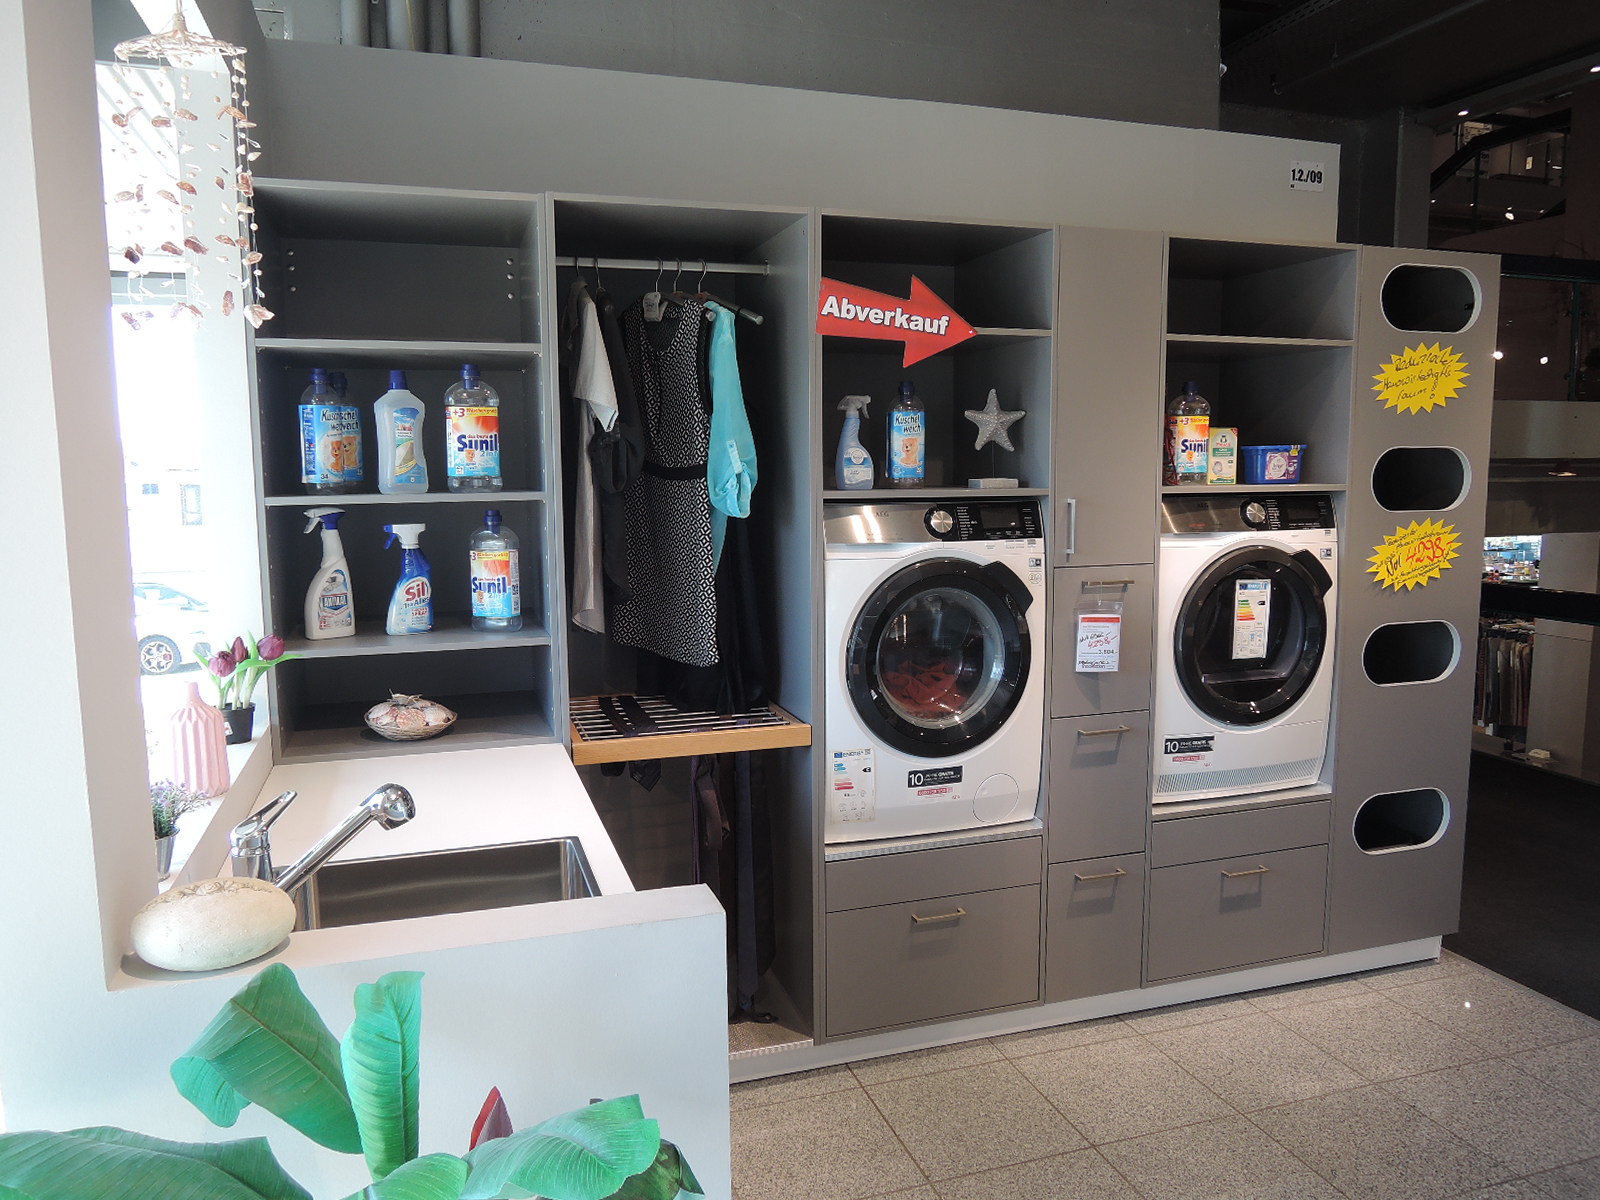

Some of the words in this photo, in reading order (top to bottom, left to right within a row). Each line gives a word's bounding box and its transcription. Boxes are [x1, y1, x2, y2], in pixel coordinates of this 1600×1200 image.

[1291, 168, 1323, 184] 1.2./09
[821, 295, 950, 335] Abverkauf
[453, 408, 465, 417] +3
[894, 413, 921, 427] Kuschel
[903, 424, 921, 433] weich
[457, 433, 498, 452] Sunil
[405, 581, 426, 602] Sil
[472, 576, 507, 593] Sunil
[1165, 741, 1179, 752] 10
[909, 773, 923, 786] 10
